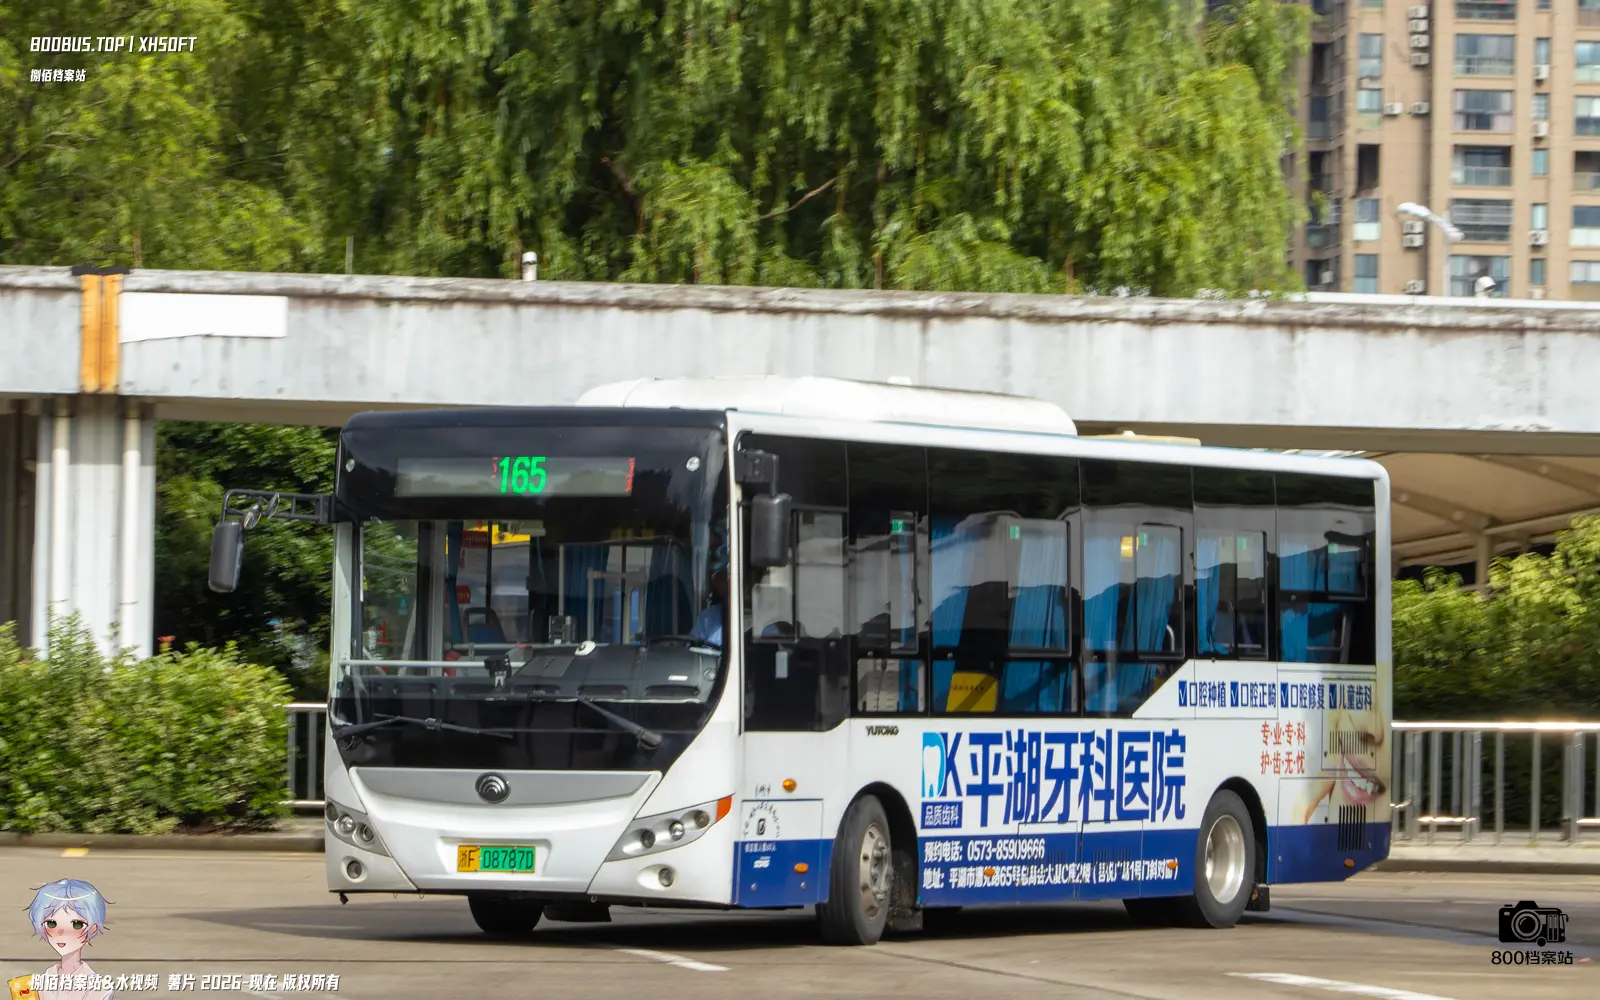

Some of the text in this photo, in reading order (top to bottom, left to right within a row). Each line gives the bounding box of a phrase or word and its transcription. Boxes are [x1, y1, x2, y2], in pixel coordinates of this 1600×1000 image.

[500, 456, 547, 494] 165
[1189, 681, 1373, 710] 口腔种植 口腔正畸 口腔修复 儿童齿科
[866, 725, 899, 736] YUTONG
[966, 729, 1186, 828] 平湖牙科医院
[924, 804, 960, 826] 品质齿科
[967, 838, 1046, 861] 0573-85909666
